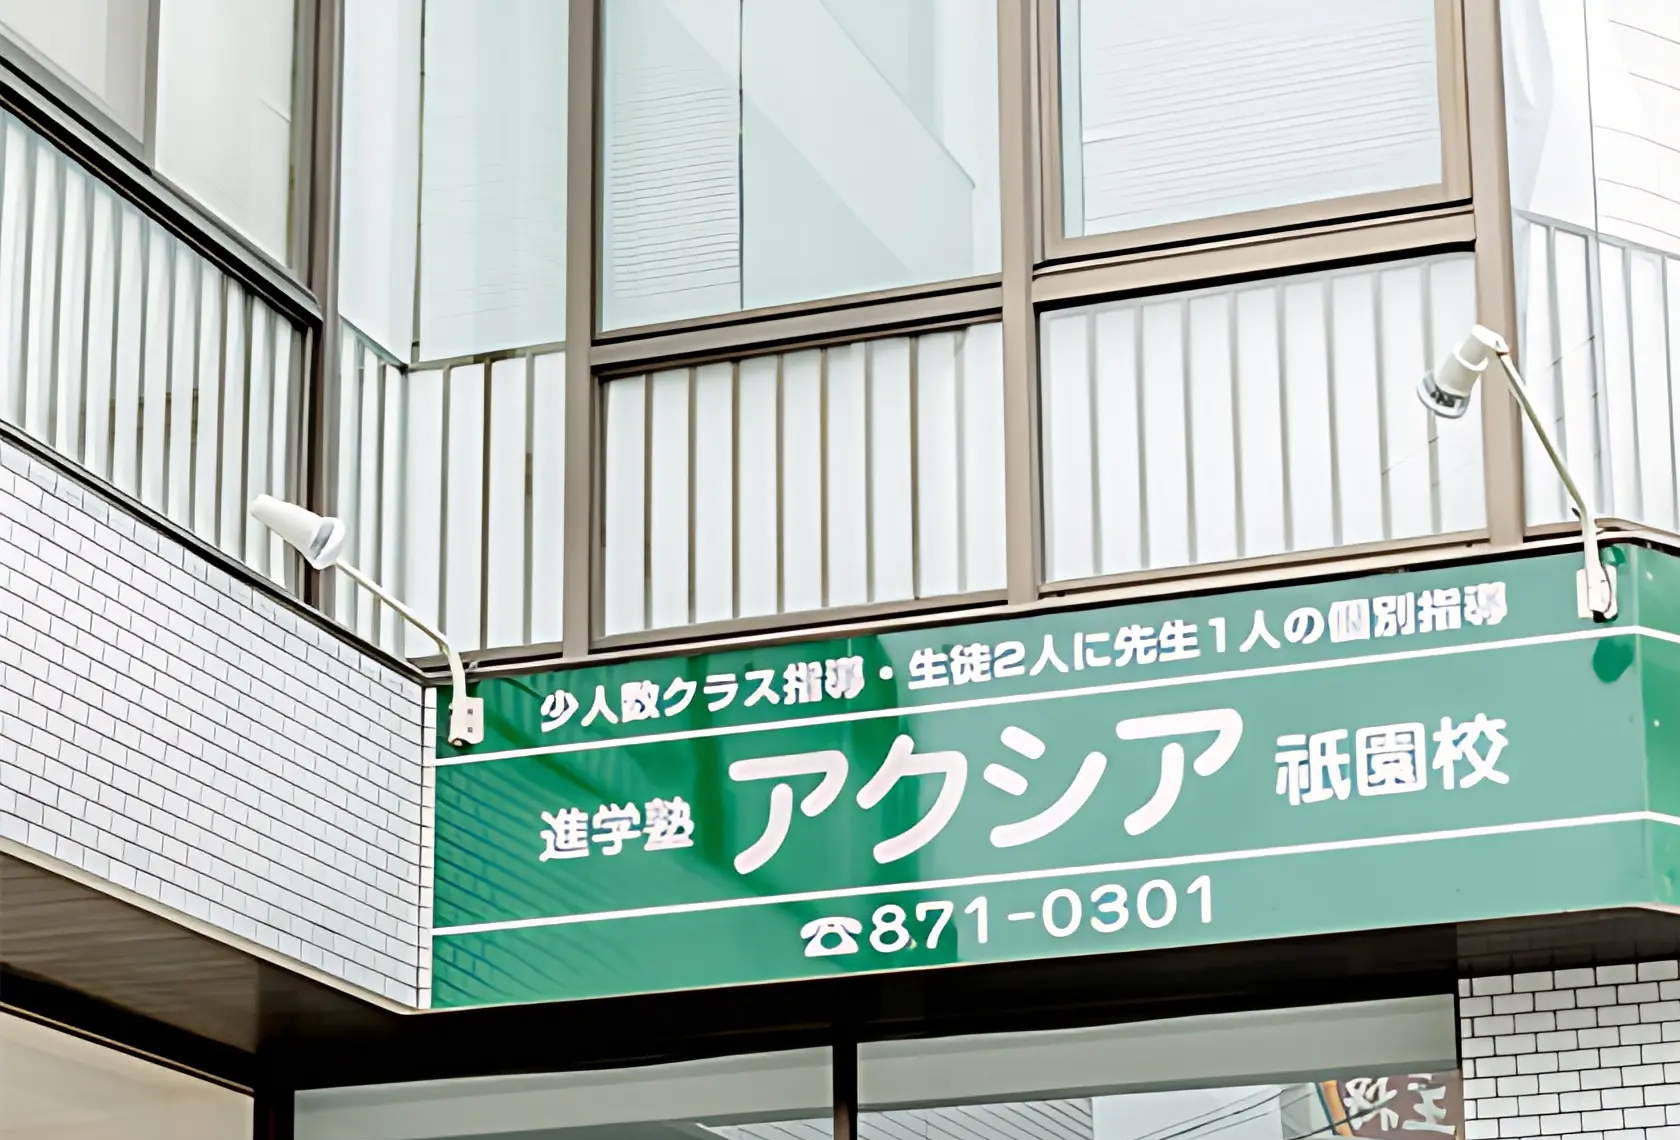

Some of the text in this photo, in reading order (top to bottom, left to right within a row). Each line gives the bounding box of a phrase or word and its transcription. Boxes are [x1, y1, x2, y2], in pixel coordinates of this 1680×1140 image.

[540, 707, 1510, 875] 進学塾 アクシア 祇園校
[869, 875, 1212, 953] 871-0301
